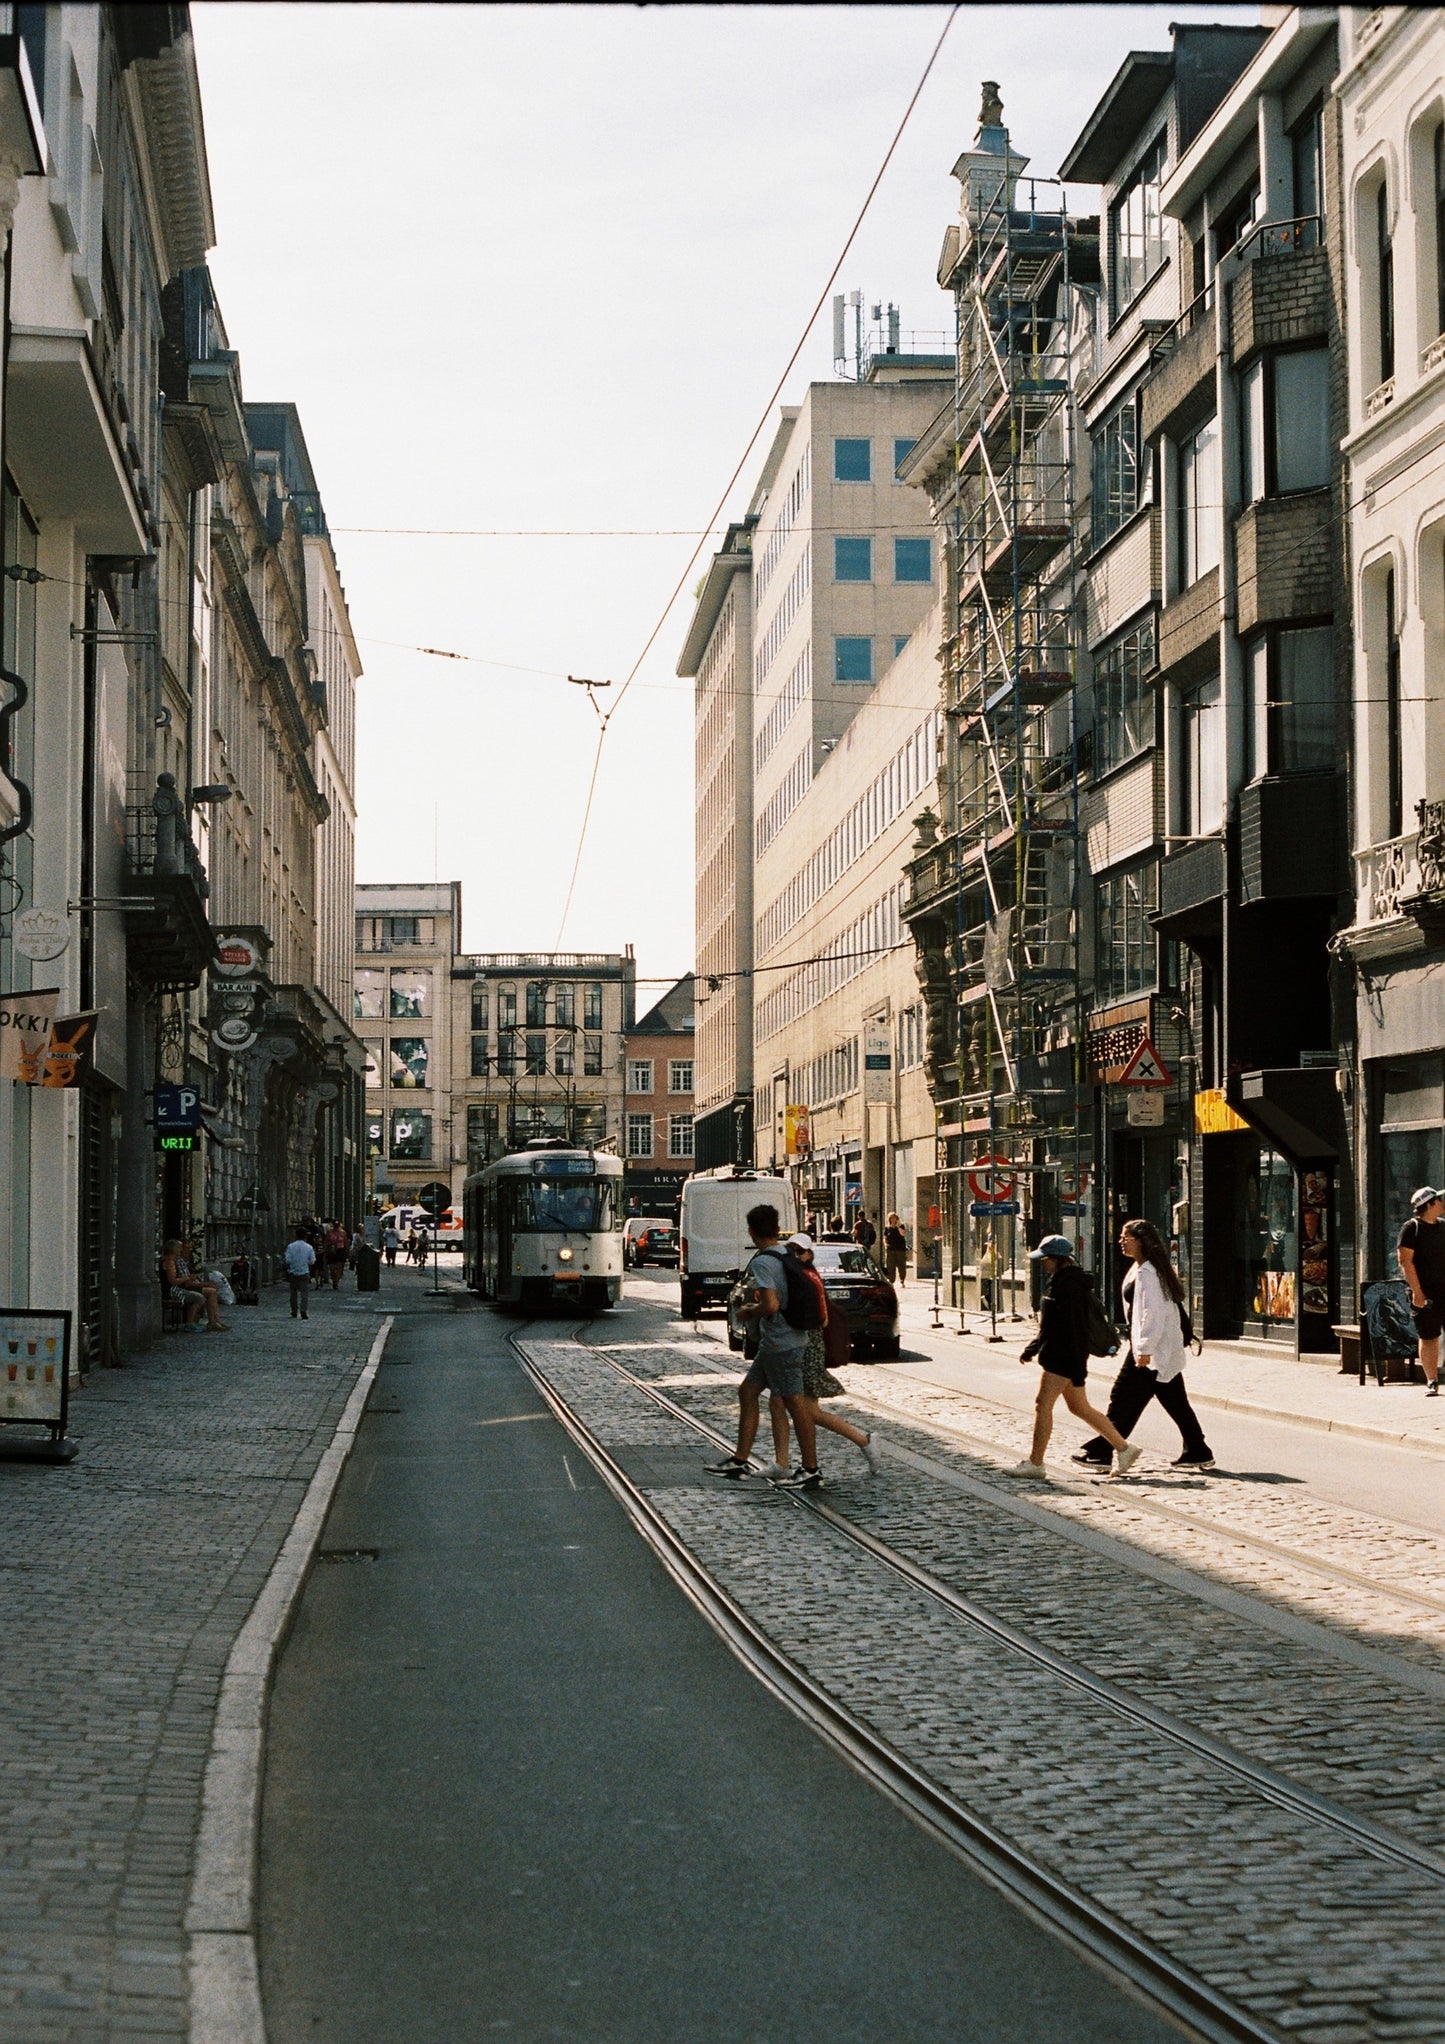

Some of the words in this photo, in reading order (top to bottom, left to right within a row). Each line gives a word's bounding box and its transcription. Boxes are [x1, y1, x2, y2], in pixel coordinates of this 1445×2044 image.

[236, 984, 253, 992] AMI
[868, 1039, 889, 1051] Ligo
[180, 1092, 197, 1116] P
[161, 1137, 193, 1150] VRIJ
